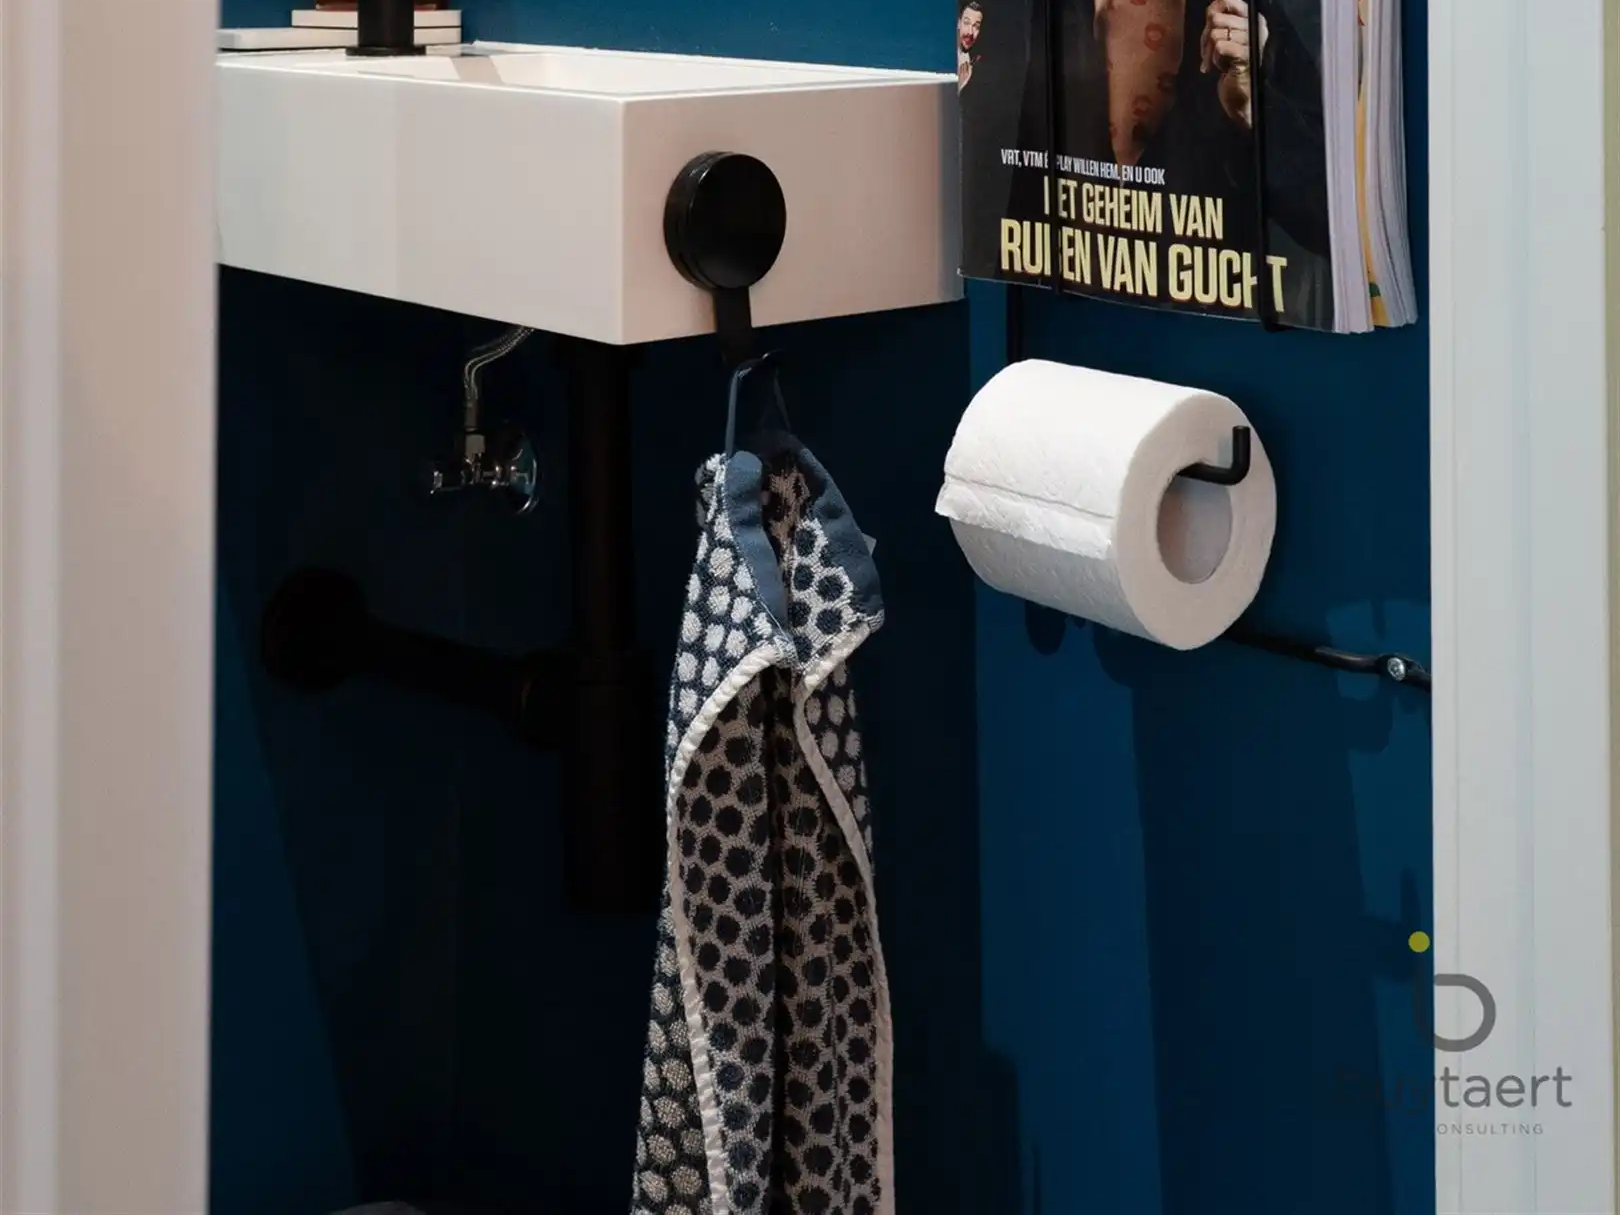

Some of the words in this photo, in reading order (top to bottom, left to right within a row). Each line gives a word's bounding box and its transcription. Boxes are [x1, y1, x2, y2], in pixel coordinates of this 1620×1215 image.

[1022, 150, 1044, 169] VTM
[1073, 157, 1100, 177] WILLEN
[1135, 166, 1143, 184] U
[1144, 167, 1166, 185] OOK
[1081, 181, 1163, 234] GEHEIM
[1169, 192, 1223, 240] VAN
[1097, 232, 1158, 298] VAN
